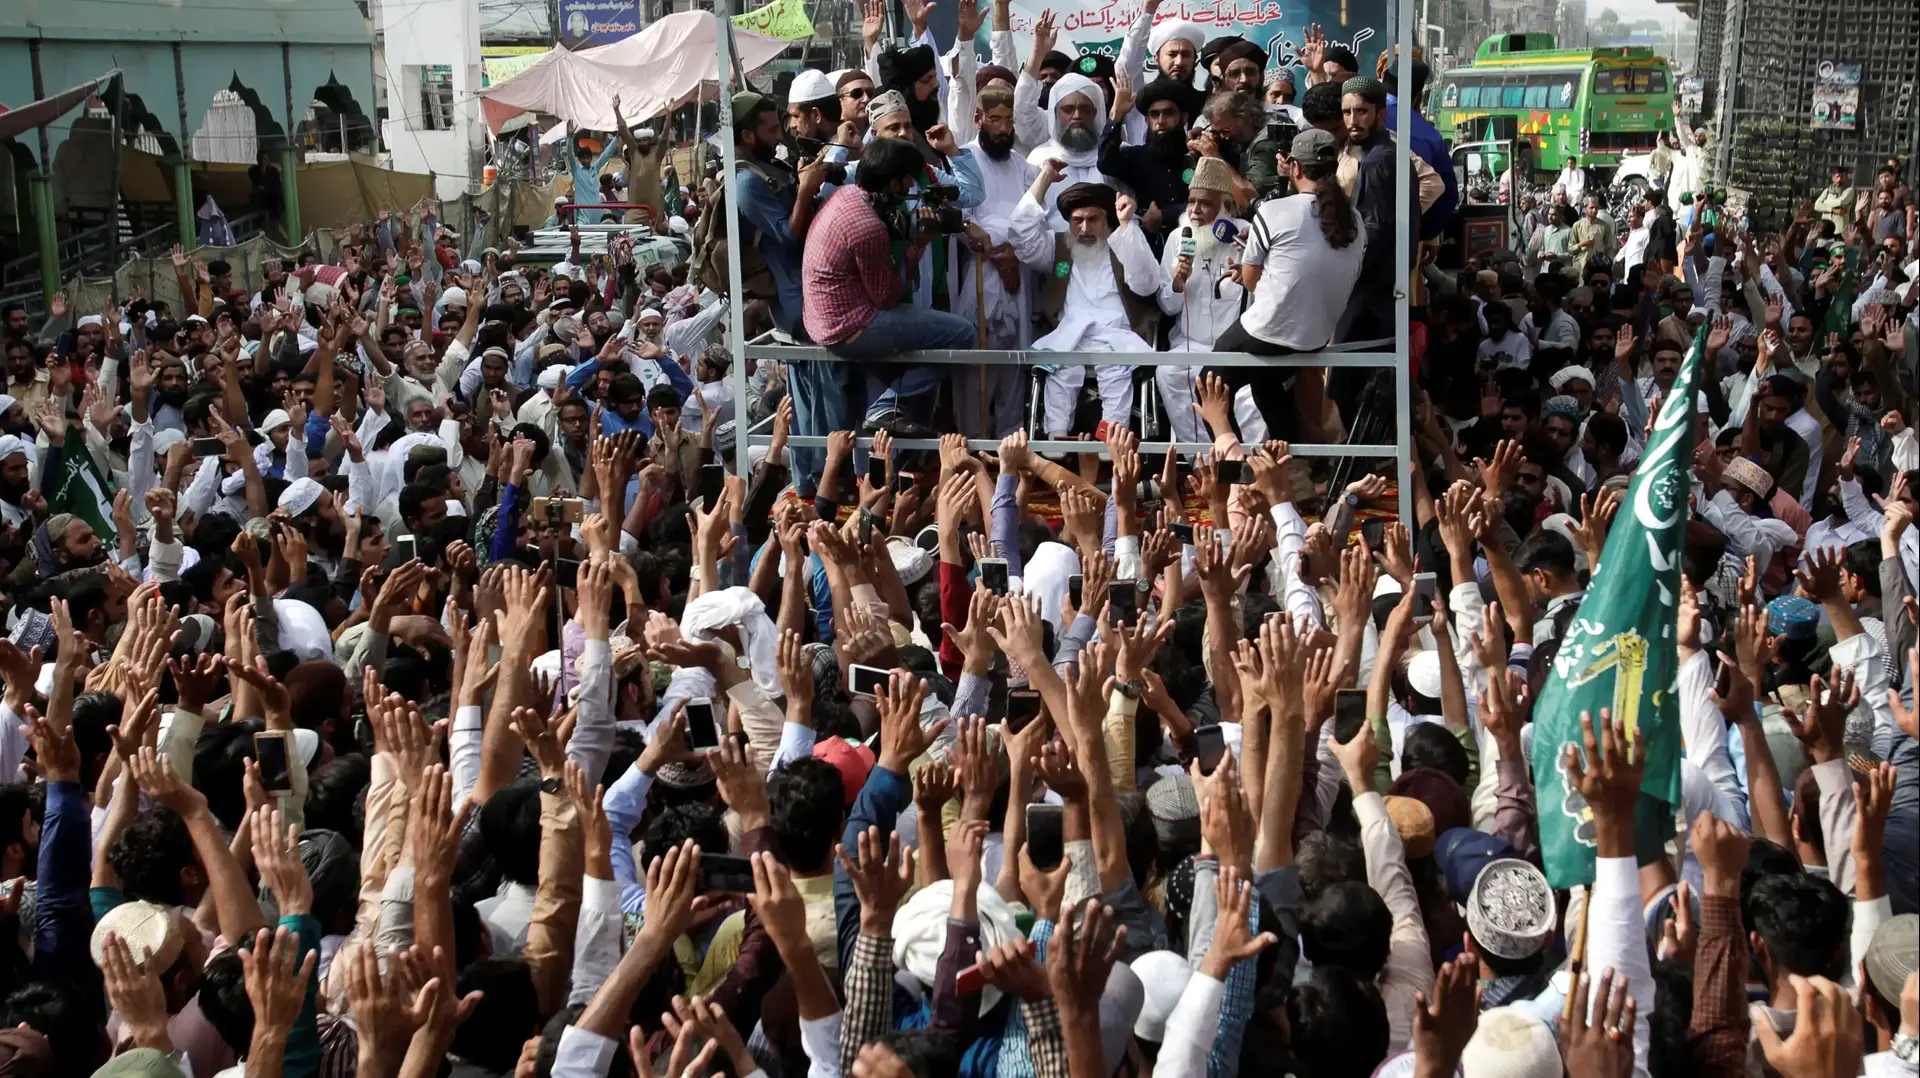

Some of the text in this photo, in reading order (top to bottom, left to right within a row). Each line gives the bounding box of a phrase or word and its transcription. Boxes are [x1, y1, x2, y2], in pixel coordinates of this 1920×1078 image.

[1063, 0, 1116, 33] پاکستان
[1192, 0, 1236, 27] لبیک
[1237, 0, 1281, 25] تحریک
